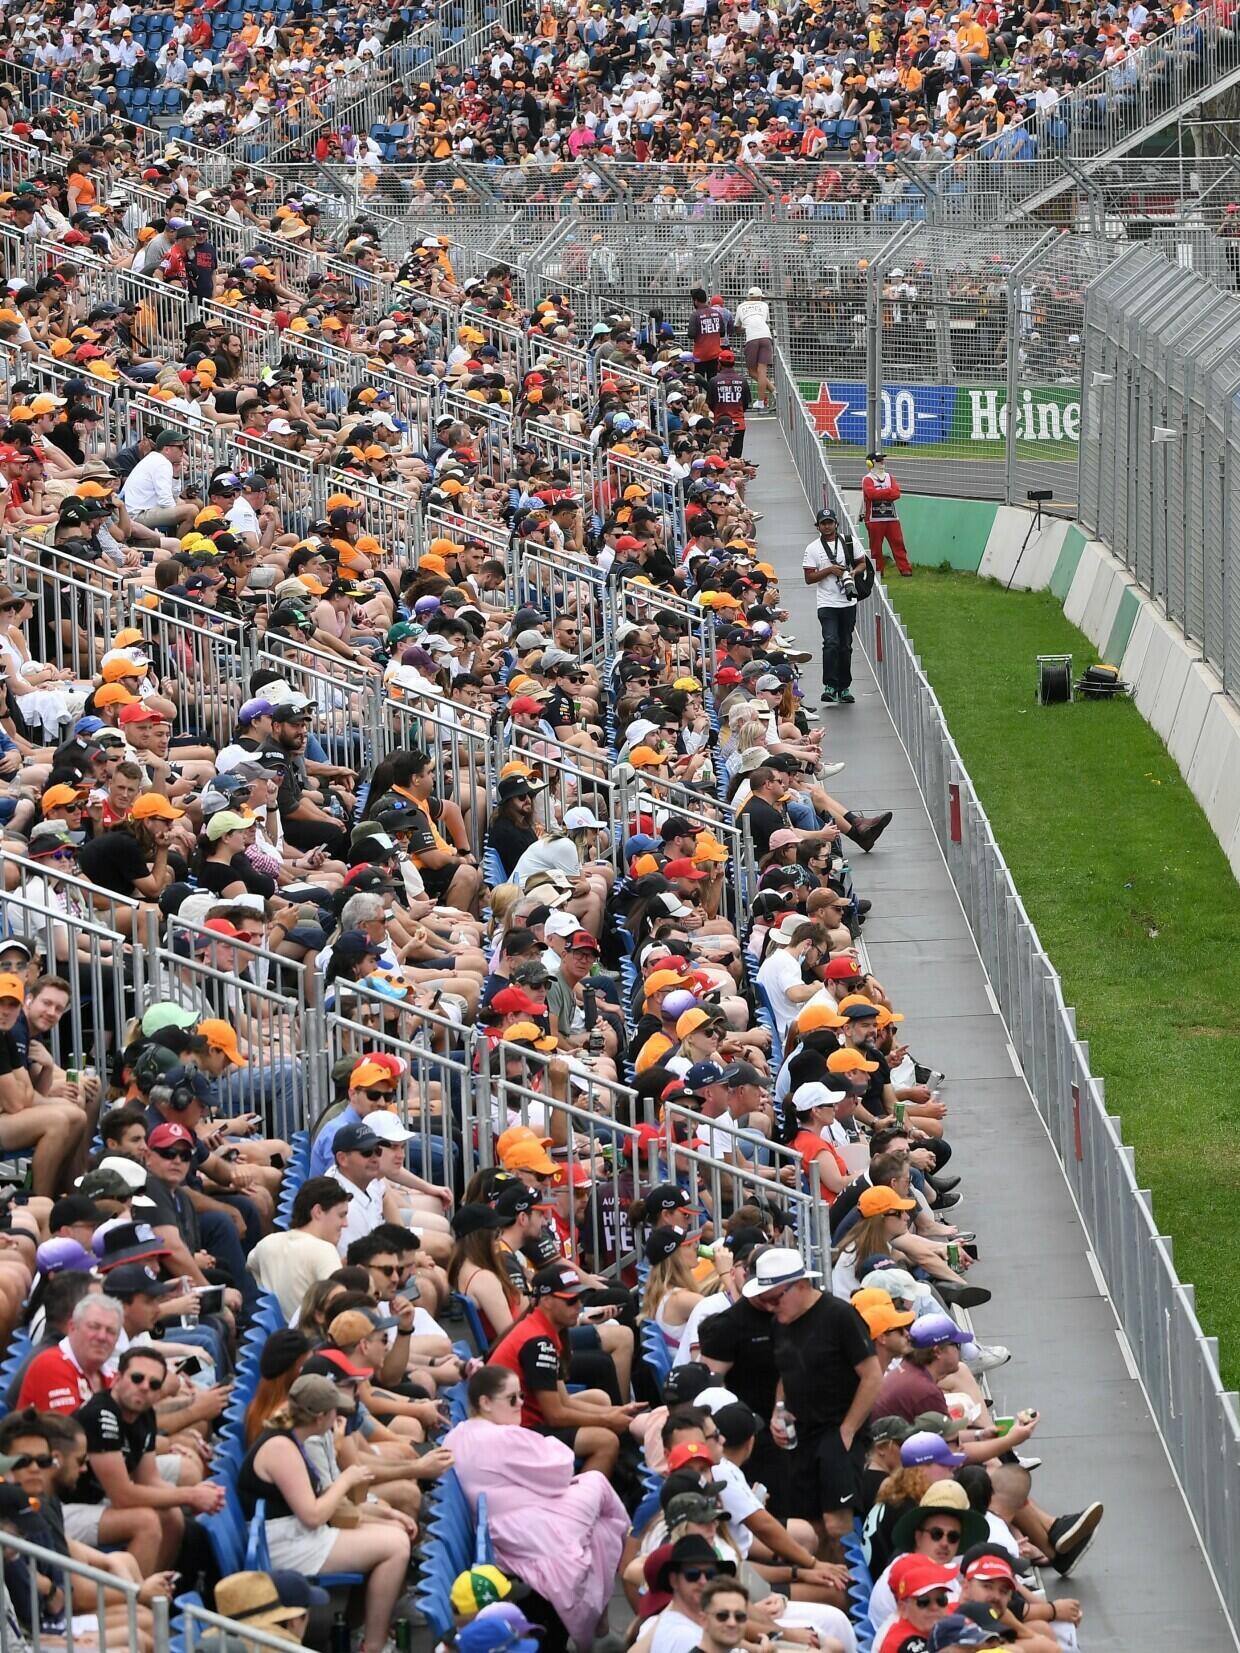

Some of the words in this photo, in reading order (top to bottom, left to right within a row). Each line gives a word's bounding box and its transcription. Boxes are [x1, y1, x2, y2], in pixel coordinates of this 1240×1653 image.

[701, 323, 720, 334] HELP
[718, 392, 742, 403] HELP
[968, 389, 1081, 440] Heine
